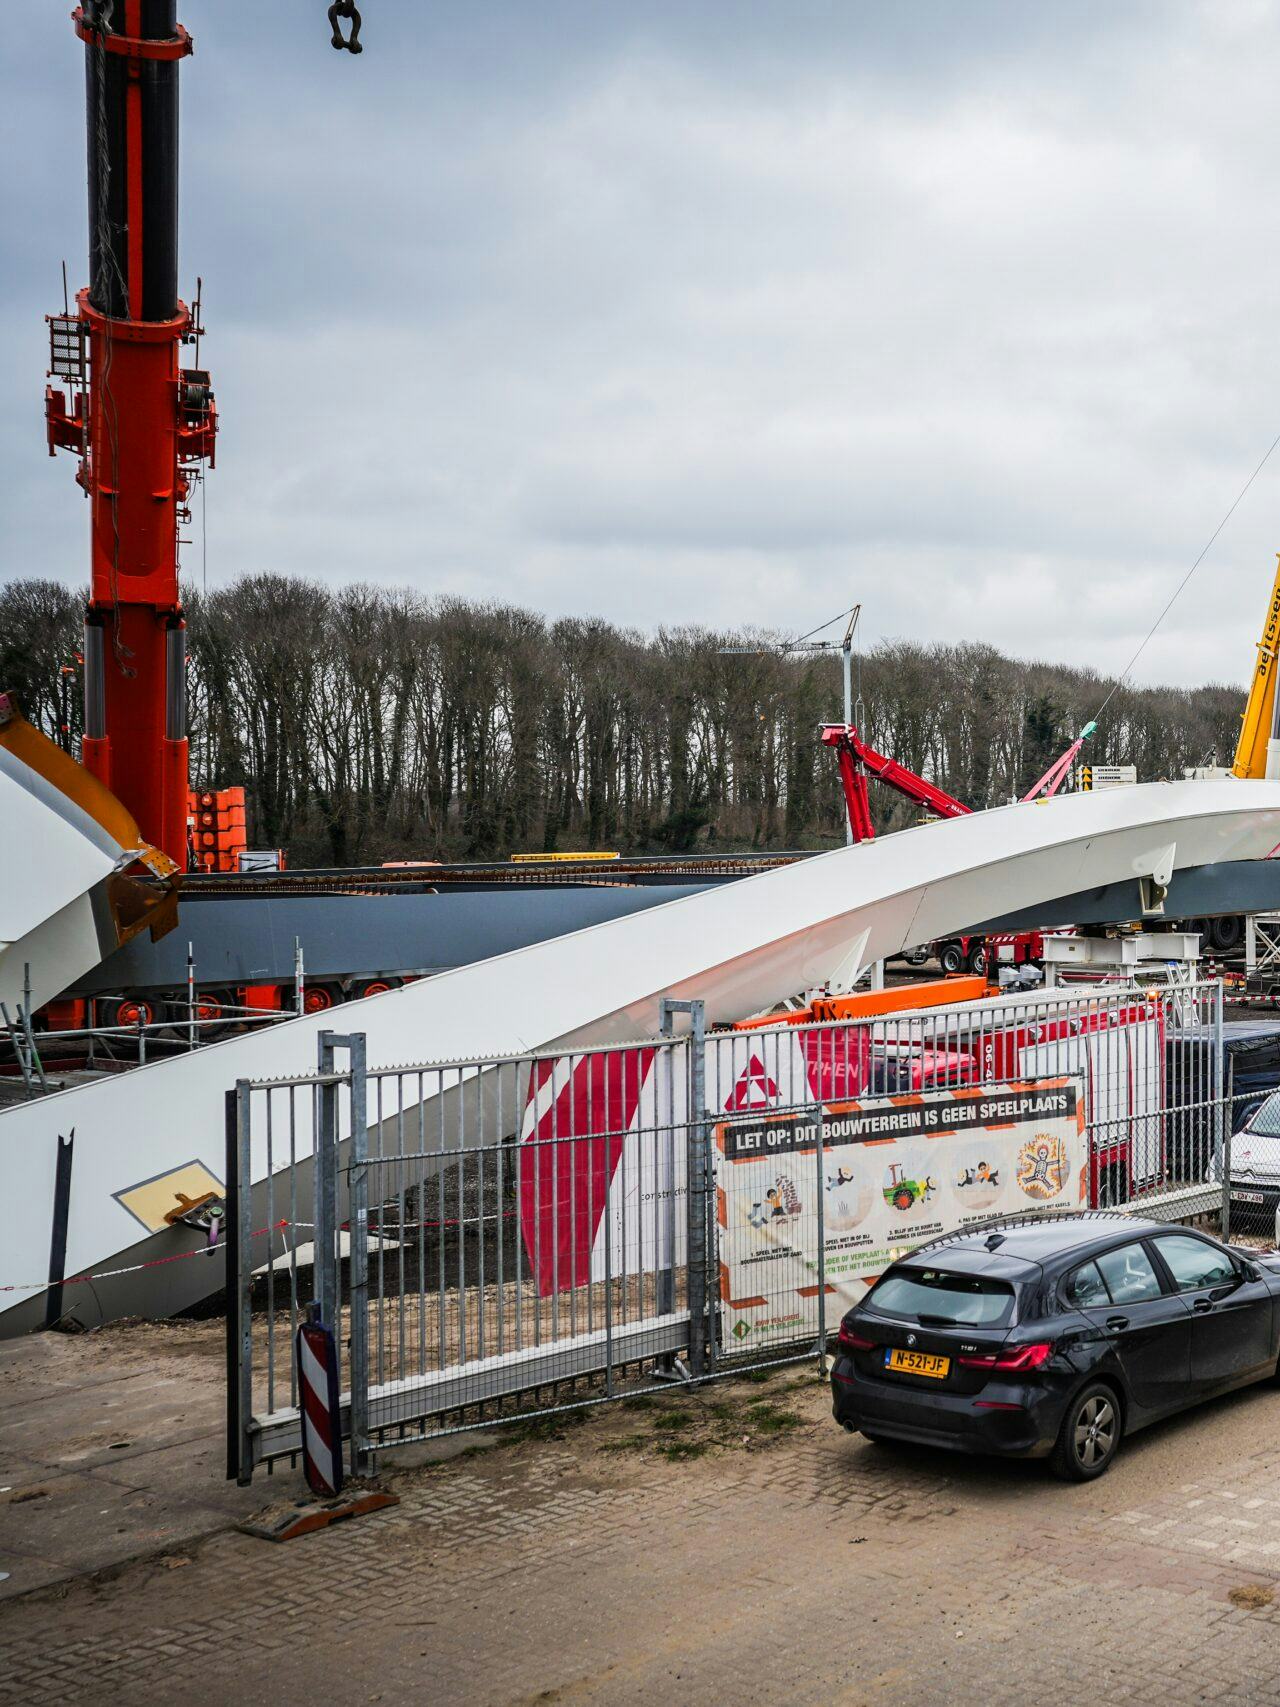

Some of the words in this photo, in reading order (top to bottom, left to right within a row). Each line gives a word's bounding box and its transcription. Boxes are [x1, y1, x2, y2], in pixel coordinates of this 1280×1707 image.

[736, 1132, 763, 1150] LET
[766, 1129, 791, 1148] OP:
[795, 1124, 818, 1143] DIT
[822, 1112, 921, 1139] BOUWTERREIN
[925, 1110, 938, 1125] IS
[942, 1105, 976, 1124] GEEN
[980, 1095, 1068, 1118] SPEELPLAATS
[896, 1351, 944, 1372] N-521-JF
